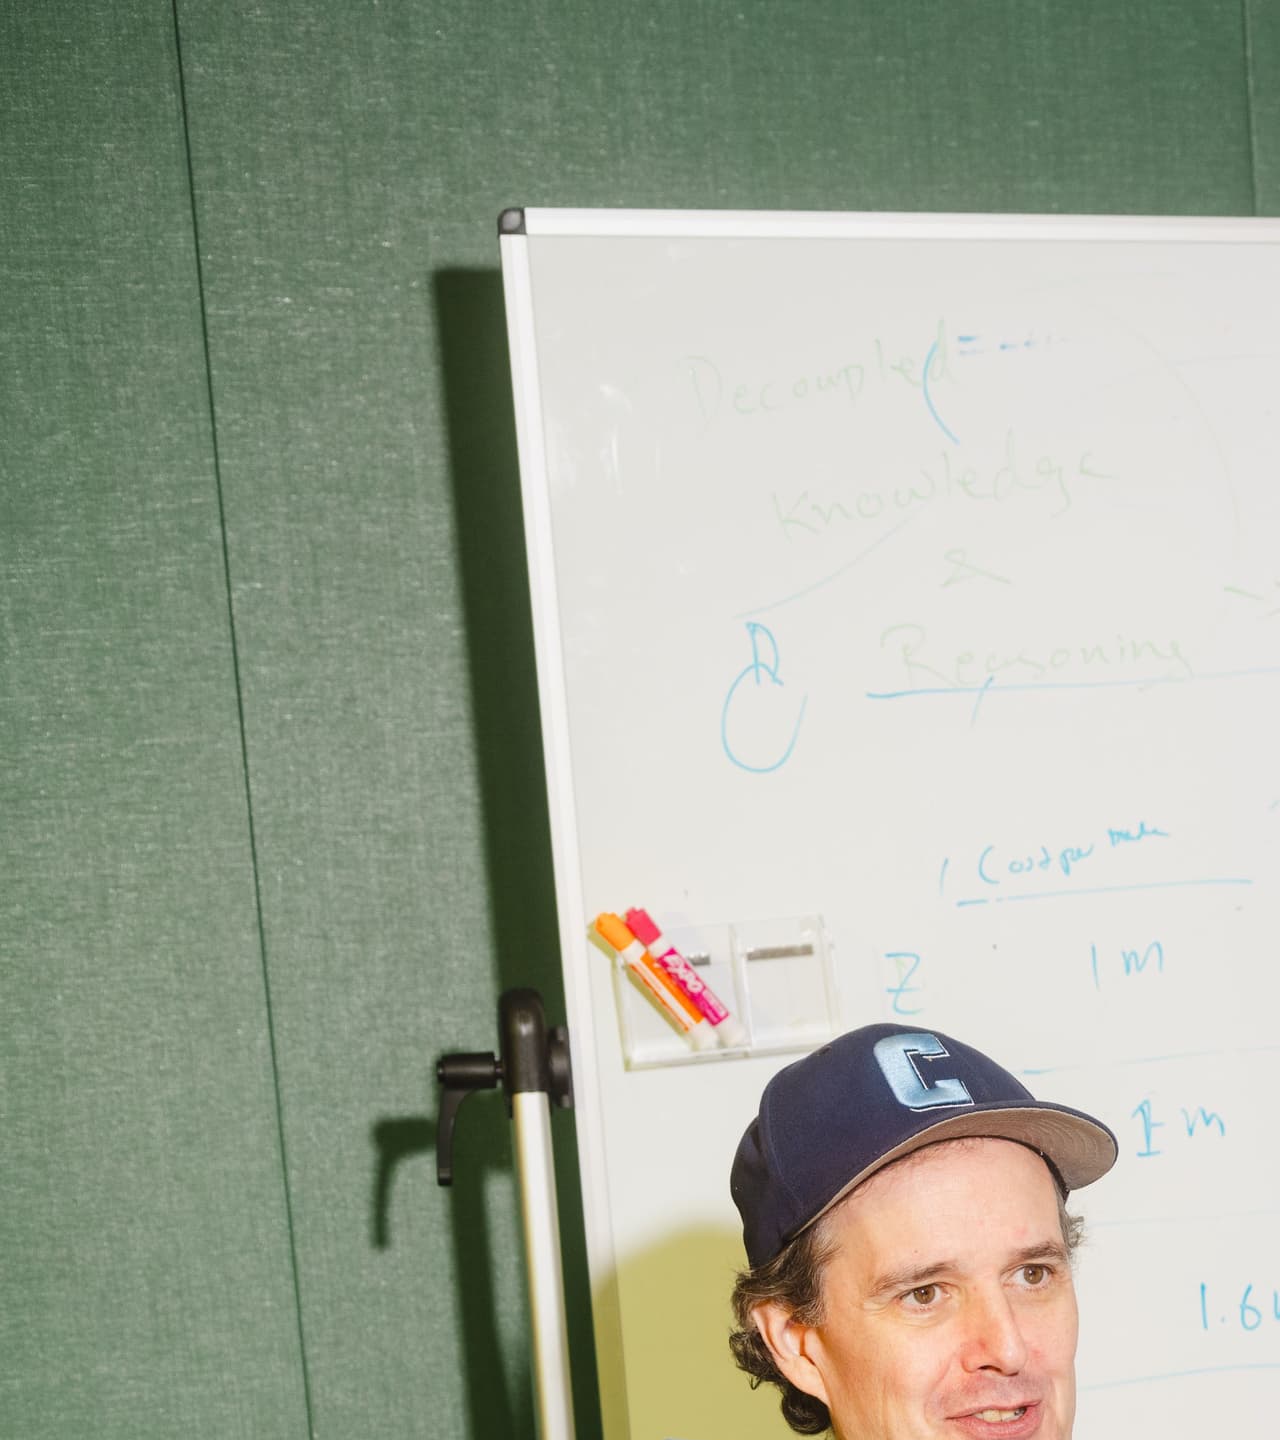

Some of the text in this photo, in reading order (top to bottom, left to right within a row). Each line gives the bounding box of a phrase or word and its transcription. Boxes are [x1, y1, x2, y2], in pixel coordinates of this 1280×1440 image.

[772, 426, 1119, 543] Knowledge
[880, 622, 1194, 691] Reasoning
[874, 1033, 975, 1112] C
